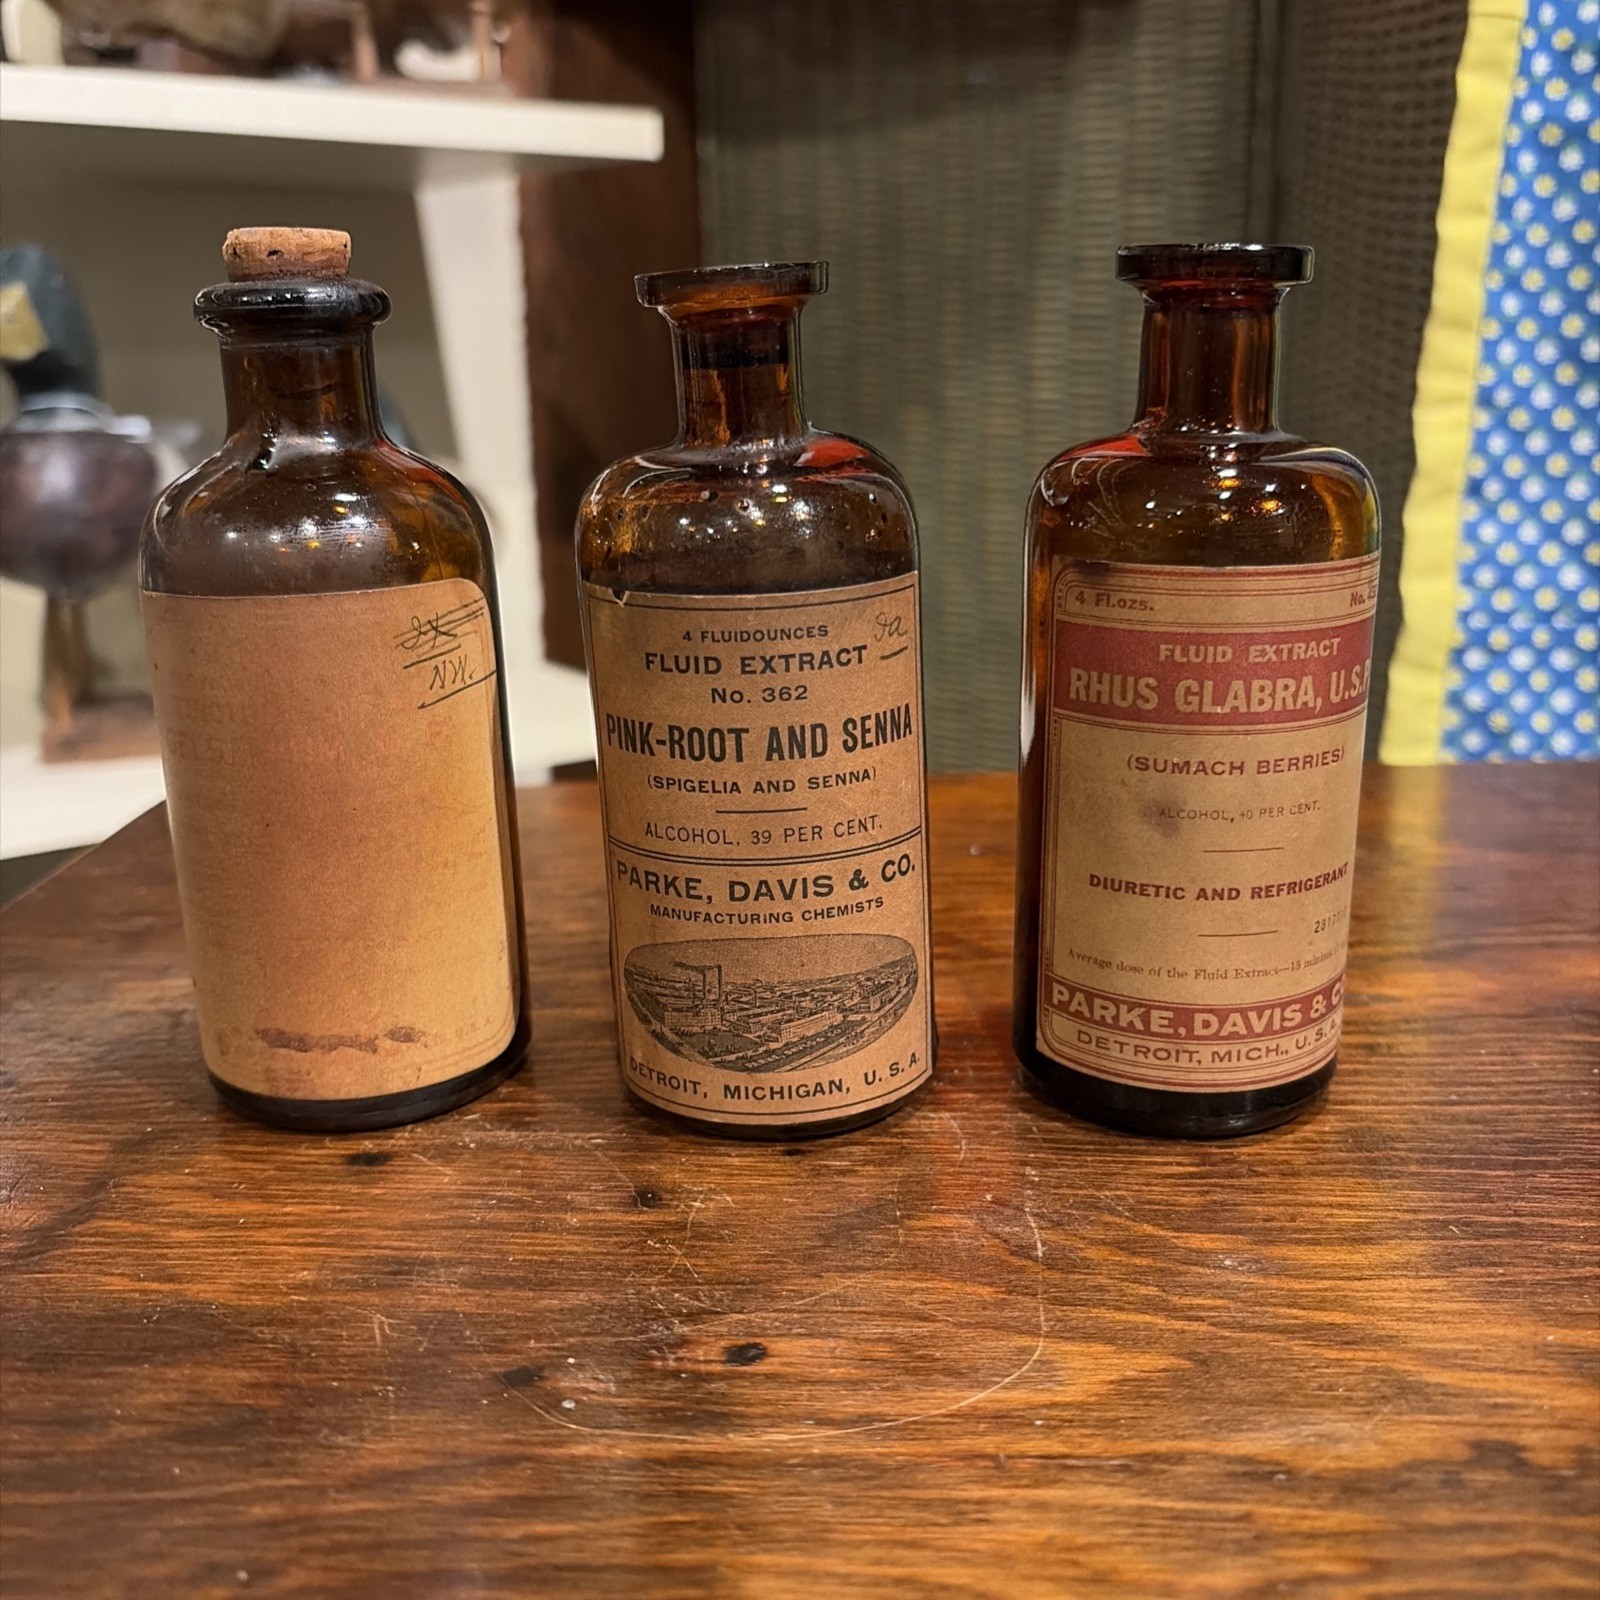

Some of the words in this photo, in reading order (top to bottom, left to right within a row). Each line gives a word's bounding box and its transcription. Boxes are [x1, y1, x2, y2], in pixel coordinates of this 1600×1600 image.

[1075, 590, 1086, 605] 4
[1350, 591, 1365, 607] No.
[682, 630, 693, 642] 4
[701, 625, 829, 643] FLUIDOUNCES
[645, 652, 722, 675] FLUID
[740, 645, 868, 675] EXTRACT
[1159, 644, 1233, 664] FLUID
[1249, 637, 1342, 663] EXTRACT
[711, 687, 751, 704] No.
[762, 685, 808, 701] 362
[1069, 667, 1159, 711] RHUS
[1175, 675, 1323, 714] GLABRA,
[606, 712, 750, 763] PINK-ROOT
[765, 722, 828, 762] AND
[842, 703, 913, 753] SENNA
[1127, 753, 1245, 776] (SUMACH
[1256, 745, 1345, 775] BERRIES)
[647, 774, 742, 795] (SPIGELIA
[753, 779, 796, 794] AND
[808, 766, 877, 791] SENNA)
[1158, 807, 1235, 823] ALCOHOL,
[1259, 806, 1284, 819] PER
[1289, 800, 1321, 816] CENT.
[645, 821, 741, 847] ALCOHOL,
[751, 829, 773, 845] 39
[784, 825, 824, 843] PER
[833, 814, 883, 838] CENT.
[616, 859, 714, 905] PARKE,
[729, 875, 834, 903] DAVIS
[849, 868, 869, 891] &
[881, 853, 916, 883] CO.
[1089, 873, 1186, 901] DIURETIC
[1195, 887, 1241, 901] AND
[1250, 861, 1348, 900] REFRIGERANT
[650, 903, 794, 925] MANUFACTURING
[801, 896, 884, 922] CHEMISTS
[1068, 948, 1112, 970] Average
[1116, 961, 1144, 974] dose
[1149, 967, 1162, 977] of
[1167, 967, 1188, 979] the
[1194, 968, 1228, 980] Fluid
[1052, 981, 1187, 1038] PARKE,
[1193, 1003, 1303, 1036] DAVIS
[1310, 994, 1327, 1019] &
[1077, 1029, 1202, 1066] DETROIT,
[629, 1055, 708, 1100] DETROIT,
[723, 1078, 851, 1101] MICHIGAN,
